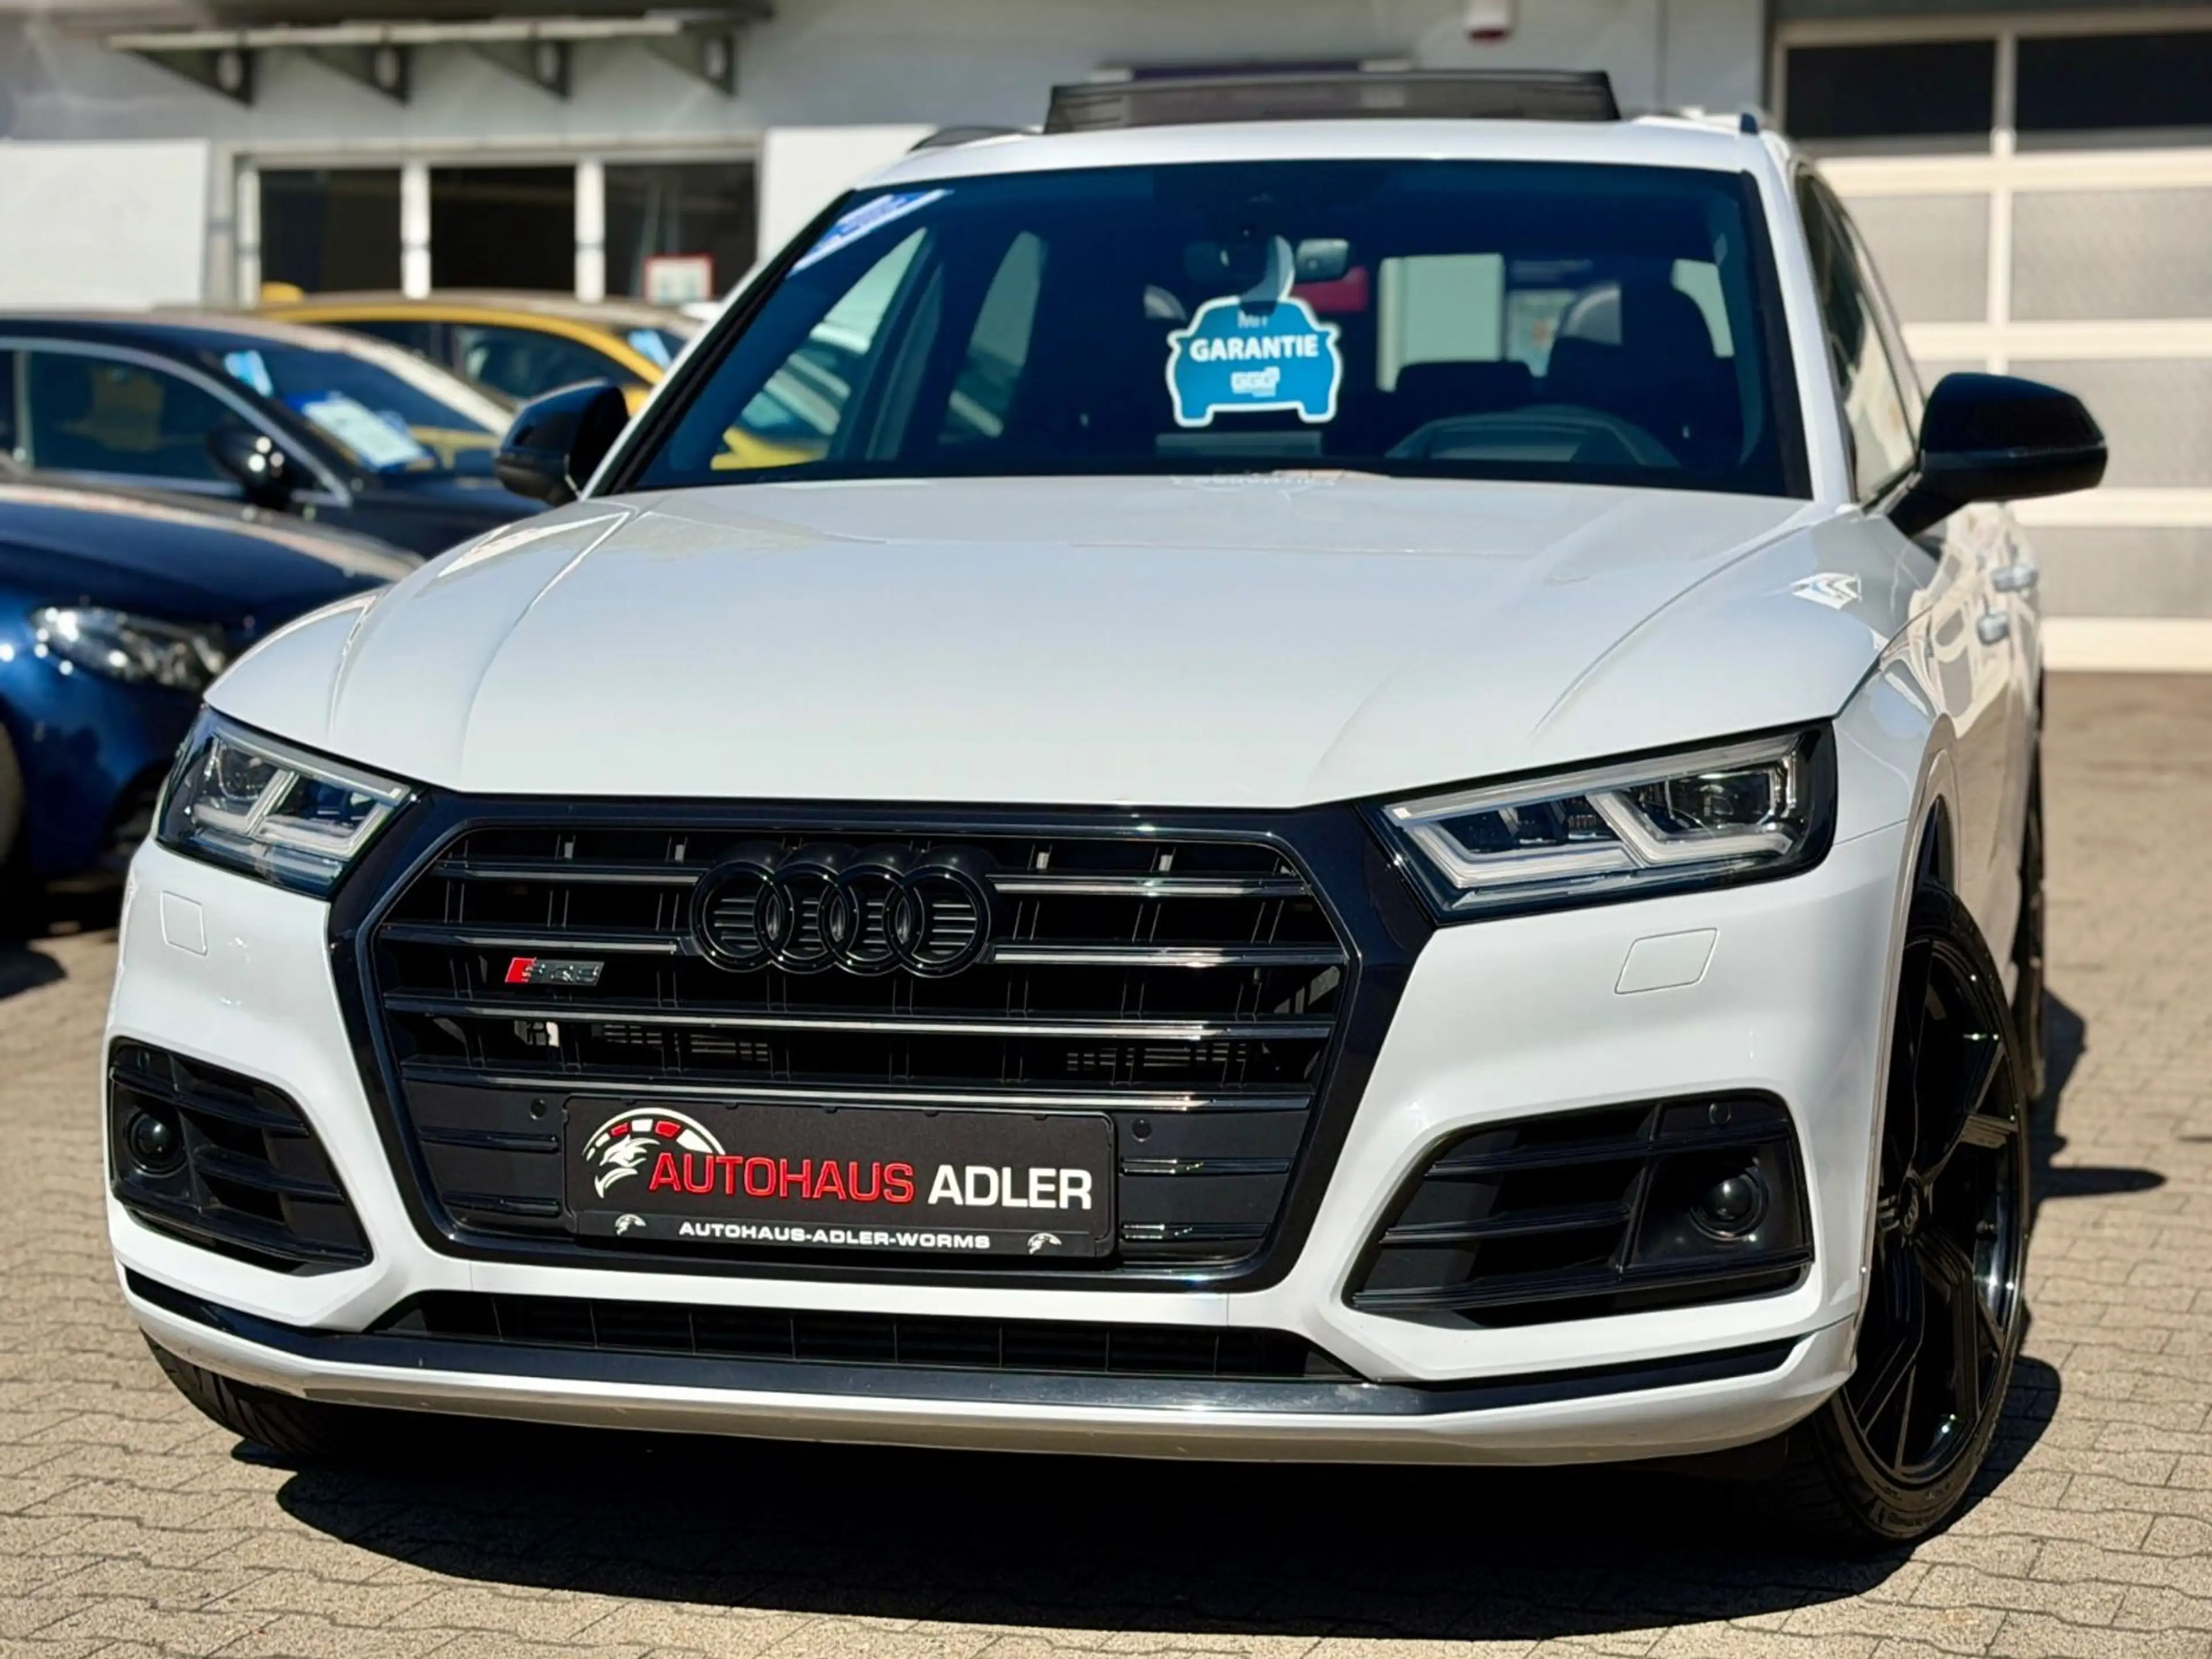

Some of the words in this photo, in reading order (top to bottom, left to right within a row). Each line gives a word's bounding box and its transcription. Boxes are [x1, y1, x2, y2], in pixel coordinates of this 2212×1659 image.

[1189, 334, 1319, 362] GARANTIE
[649, 1152, 915, 1204] AUTOHAUS
[927, 1164, 1092, 1210] ADLER
[679, 1221, 991, 1249] AUTOHAUS-ADLER-WORMS
